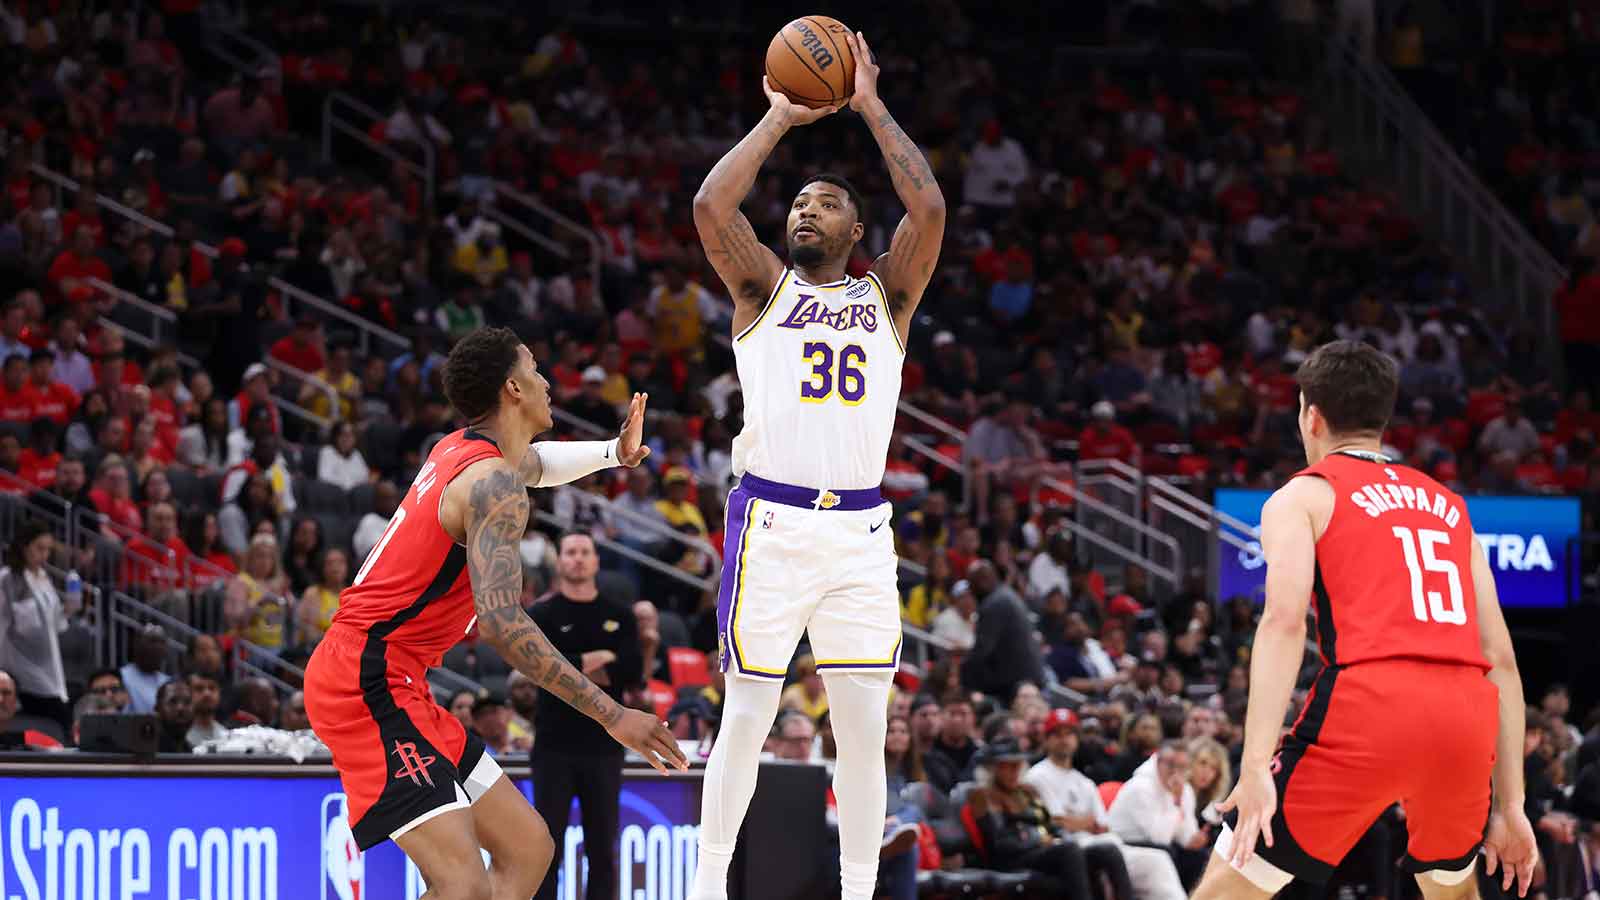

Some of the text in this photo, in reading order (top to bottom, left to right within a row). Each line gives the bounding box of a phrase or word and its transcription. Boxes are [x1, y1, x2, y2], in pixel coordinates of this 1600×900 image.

[777, 294, 878, 333] LAKERS
[800, 341, 868, 406] 36
[1350, 484, 1461, 529] SHEPPARD
[1392, 526, 1467, 625] 15
[0, 798, 278, 900] Storecom
